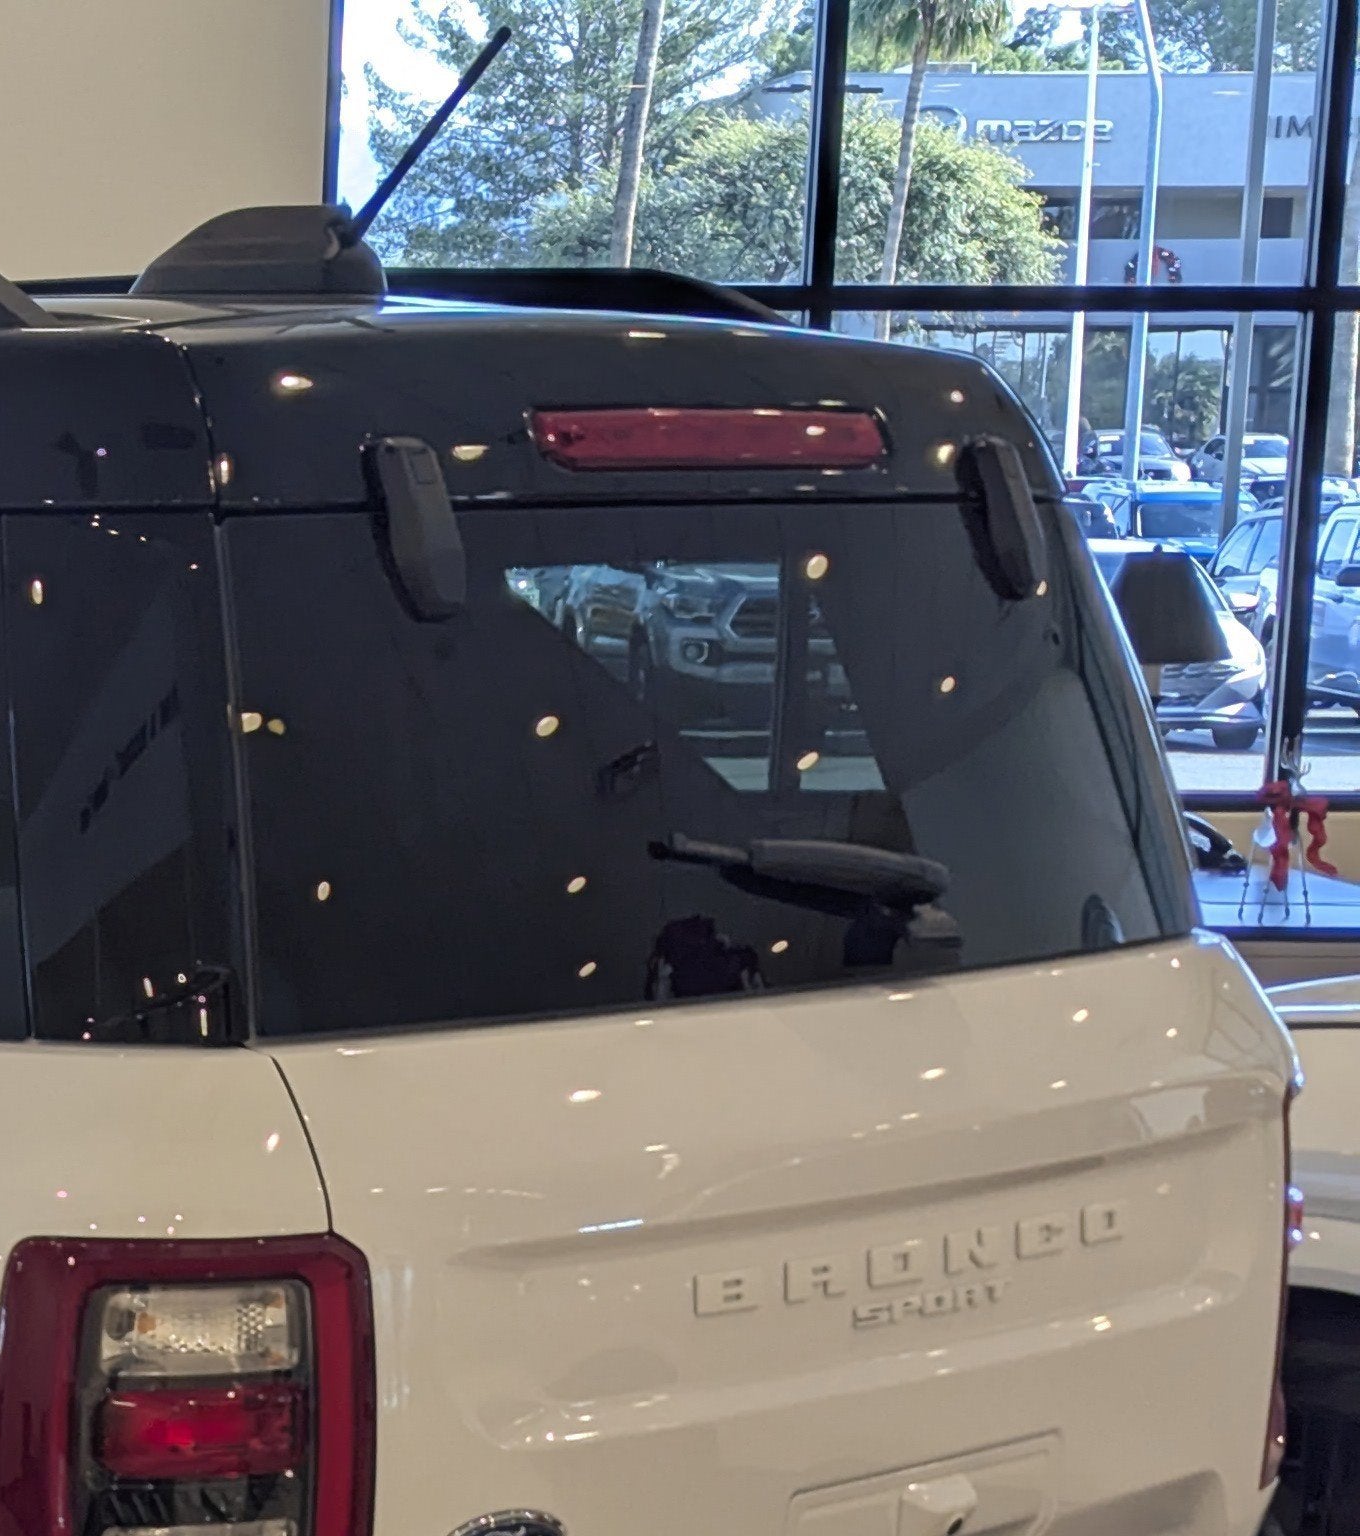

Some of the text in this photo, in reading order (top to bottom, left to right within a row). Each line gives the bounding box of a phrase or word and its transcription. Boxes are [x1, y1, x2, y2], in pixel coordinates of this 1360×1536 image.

[1266, 114, 1315, 139] IM
[692, 1203, 1128, 1317] BRONCO
[852, 1281, 1010, 1329] SPORT
